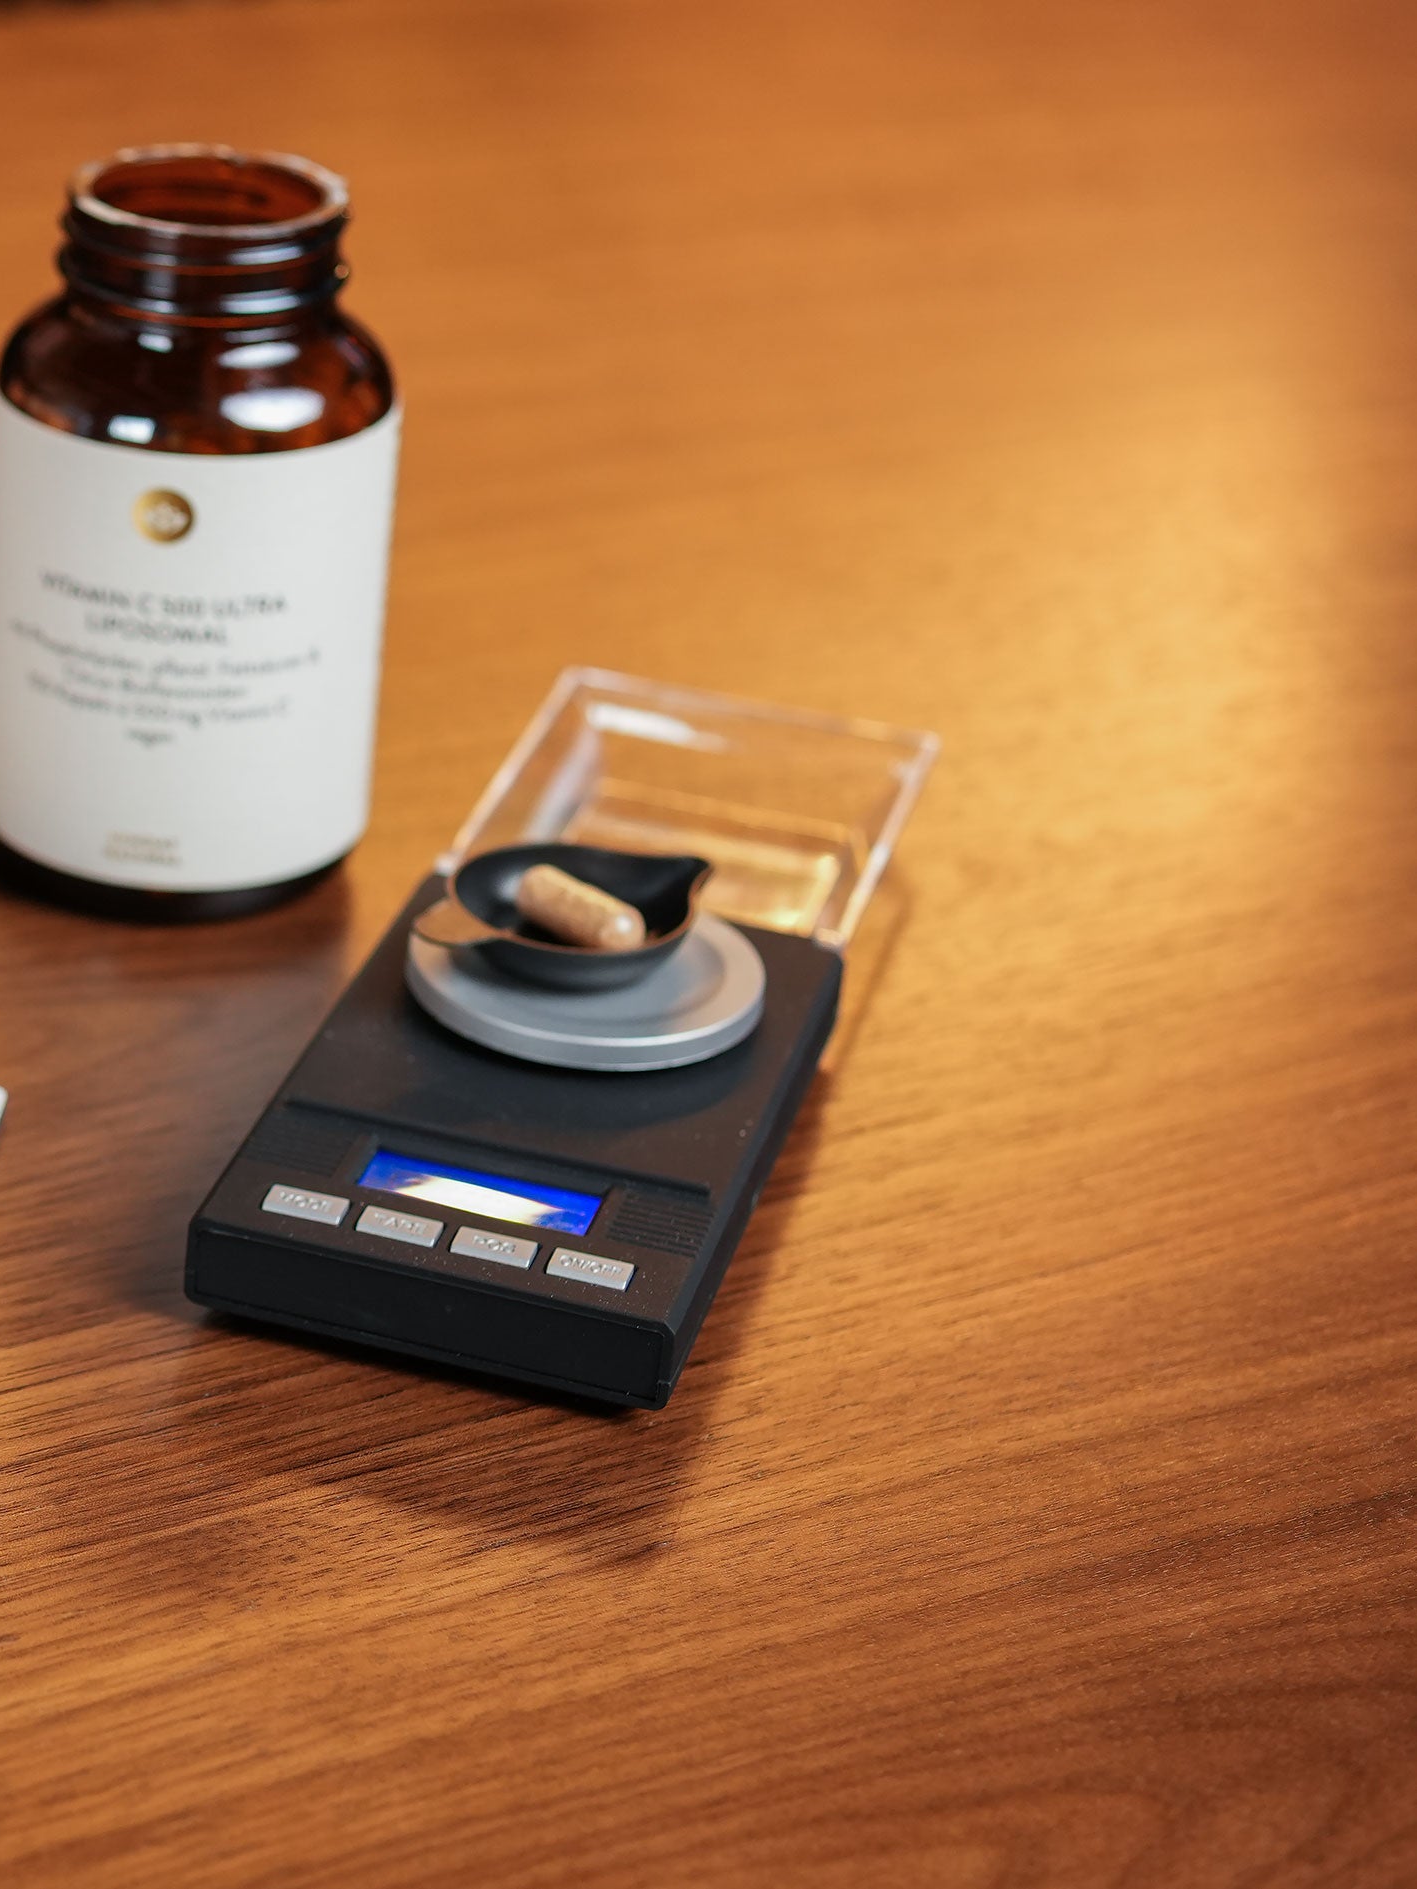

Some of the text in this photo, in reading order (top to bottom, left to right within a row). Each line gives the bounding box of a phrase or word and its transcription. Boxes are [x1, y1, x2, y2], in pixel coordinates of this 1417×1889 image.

[40, 567, 131, 608] VITAMIN
[137, 591, 153, 616] C
[211, 592, 288, 619] ULTRA
[84, 612, 228, 645] LIPOSOMAL
[374, 1212, 429, 1235] TARE
[558, 1254, 624, 1278] ON/OFF
